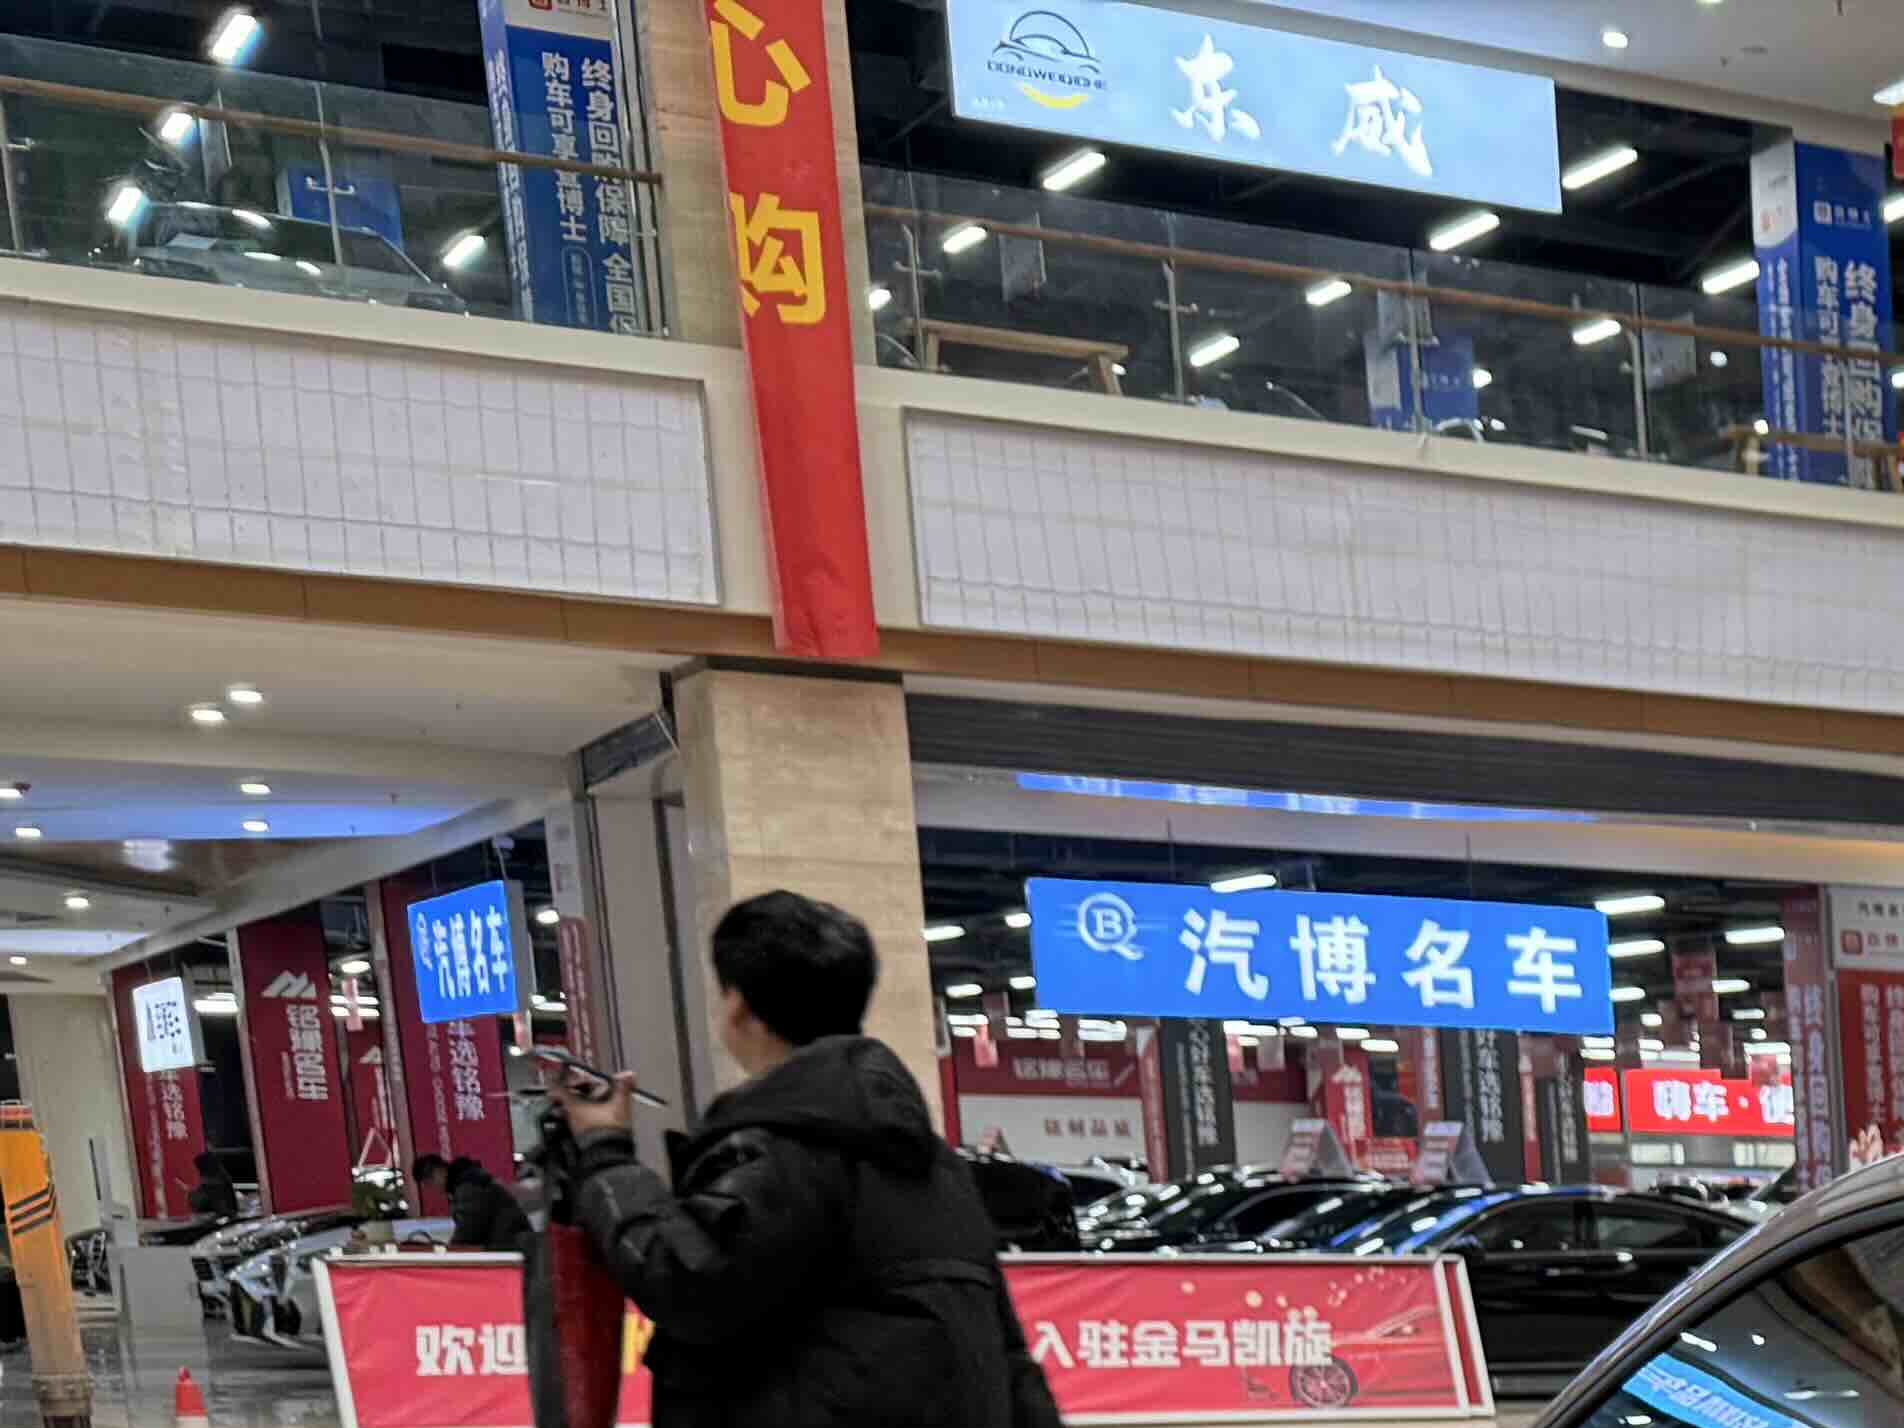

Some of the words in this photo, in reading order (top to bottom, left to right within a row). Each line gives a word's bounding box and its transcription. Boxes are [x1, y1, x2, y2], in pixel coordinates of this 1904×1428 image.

[1170, 33, 1434, 177] 东威
[1179, 908, 1584, 1015] 汽博名车
[415, 1323, 528, 1376] 欢迎
[1031, 1319, 1333, 1369] 入驻金马凯旋
